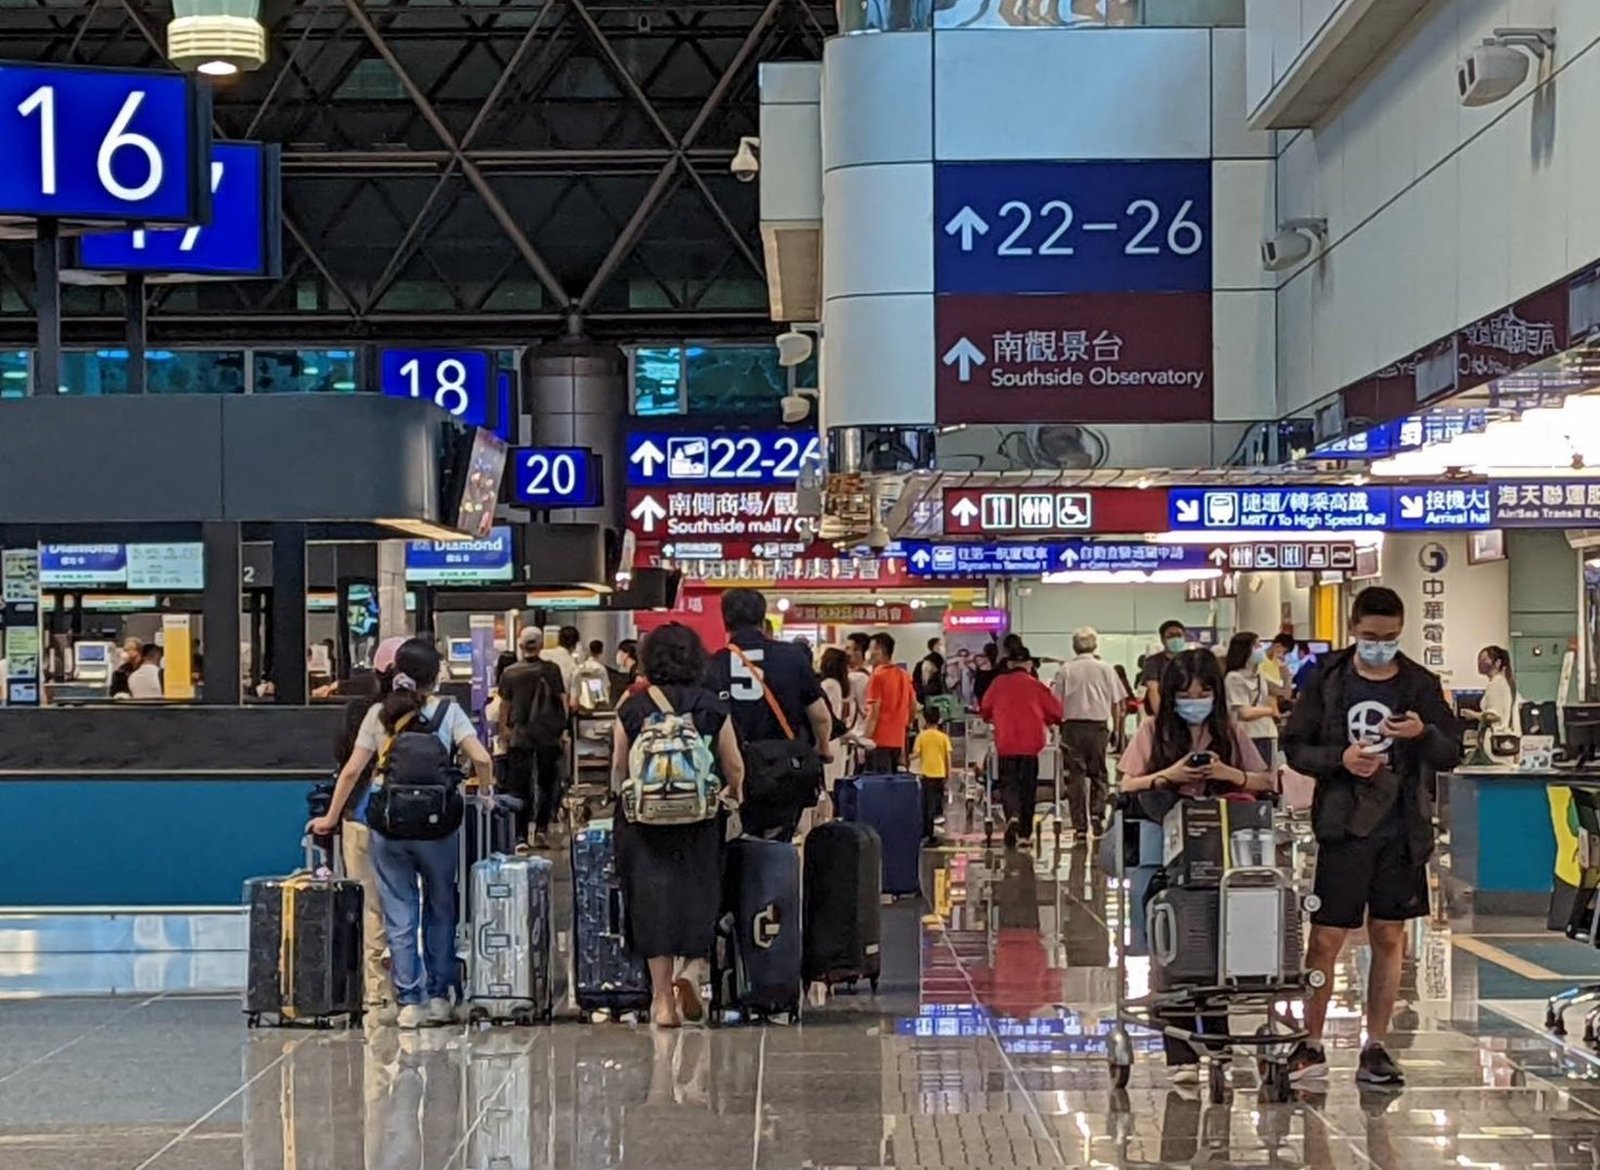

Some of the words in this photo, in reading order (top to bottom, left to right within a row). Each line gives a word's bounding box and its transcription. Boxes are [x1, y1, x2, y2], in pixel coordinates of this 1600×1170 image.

[17, 85, 163, 201] 16
[991, 331, 1123, 364] 南觀景台
[400, 359, 468, 416] 18
[991, 367, 1084, 387] Southside
[1089, 366, 1204, 388] Observatory
[526, 454, 576, 495] 20
[667, 518, 745, 534] Southside
[748, 518, 782, 533] mall
[1278, 514, 1293, 526] To
[1294, 514, 1322, 529] High
[1325, 514, 1363, 528] Speed
[1365, 513, 1386, 525] Rail
[1425, 512, 1467, 524] Arrival
[1542, 508, 1581, 519] Transit
[243, 567, 254, 582] 2
[1423, 578, 1445, 666] 中華電信
[730, 649, 764, 701] 5
